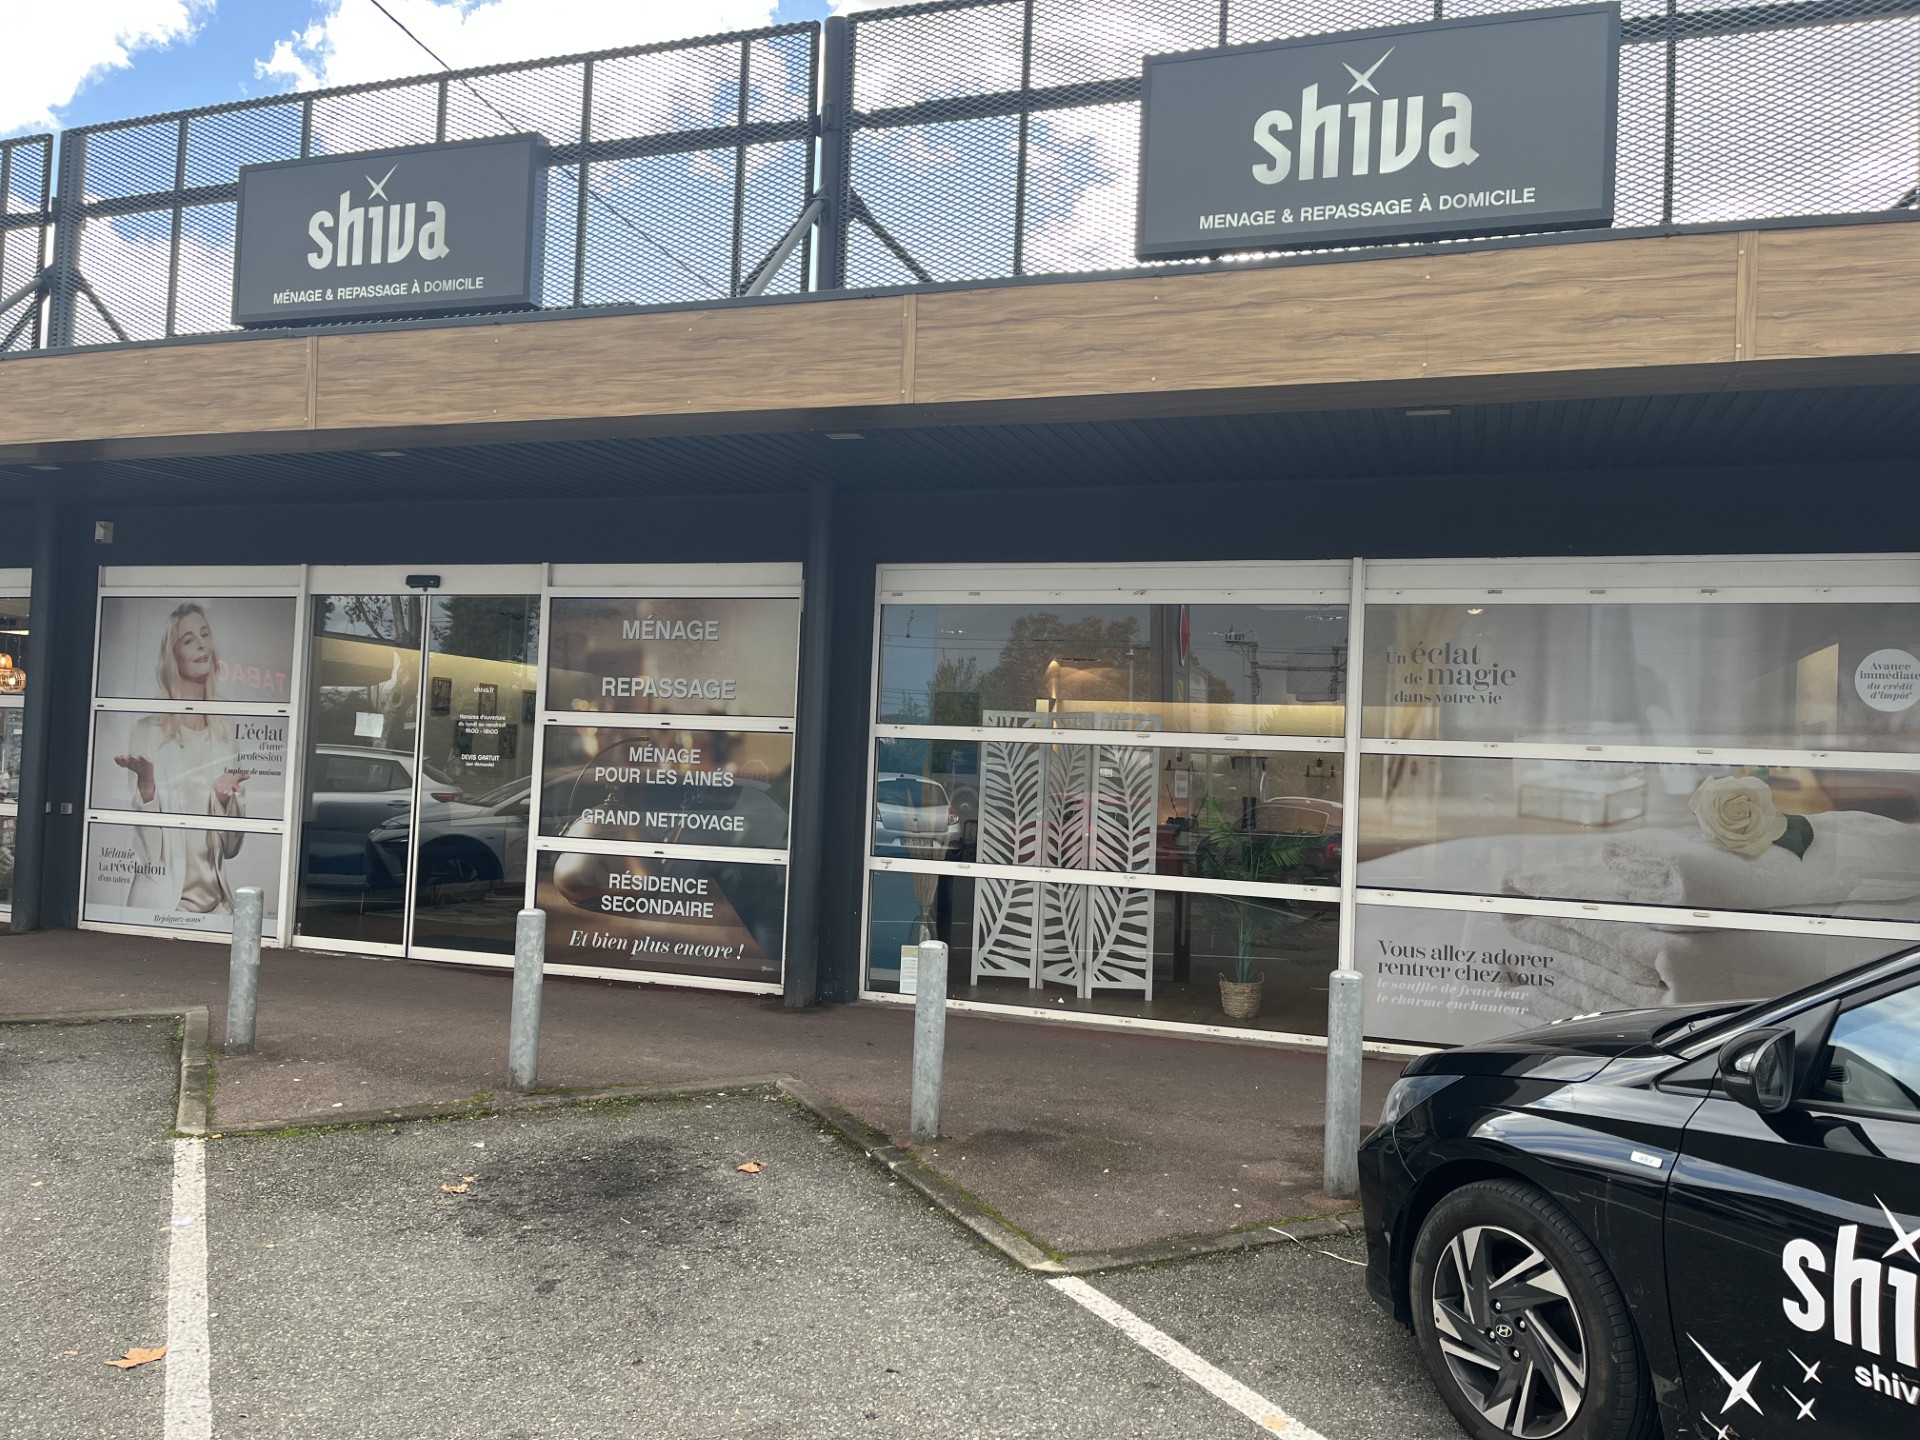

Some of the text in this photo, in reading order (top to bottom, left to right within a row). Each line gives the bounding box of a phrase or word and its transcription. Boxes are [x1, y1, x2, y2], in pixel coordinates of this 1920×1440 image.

[1252, 83, 1480, 185] shiva
[1200, 187, 1535, 230] MENAGE & REPASSAGE À DOMICILE
[307, 190, 450, 270] shiva
[273, 277, 484, 304] MÉNAGE & REPASSAGE À DOMICILE
[622, 615, 719, 641] MÉNAGE
[1384, 641, 1480, 665] Un éclat
[1404, 663, 1516, 691] de magie
[1860, 670, 1920, 680] immédiate
[1871, 662, 1911, 670] Avance
[602, 677, 737, 700] REPASSAGE
[1394, 690, 1502, 704] dans votre vie
[1867, 682, 1913, 690] du crédit
[235, 723, 283, 741] L'éclat
[238, 752, 282, 762] profession
[259, 742, 283, 751] d'une
[629, 744, 702, 764] MÉNAGE
[594, 766, 641, 784] POUR
[646, 768, 678, 785] LES
[682, 768, 734, 787] AINÉS
[581, 808, 745, 832] GRAND NETTOYAGE
[100, 847, 135, 859] Mélanie
[99, 860, 166, 876] La révélation
[608, 870, 708, 895] RÉSIDENCE
[601, 895, 714, 918] SECONDAIRE
[569, 929, 745, 960] Et bien plus encore !
[1378, 940, 1554, 968] Vous allez adorer
[1377, 961, 1555, 987] rentrer chez vous
[1377, 978, 1388, 988] le
[1391, 981, 1438, 993] souffle
[1441, 983, 1456, 993] de
[1377, 992, 1529, 1015] le charme enchanteur
